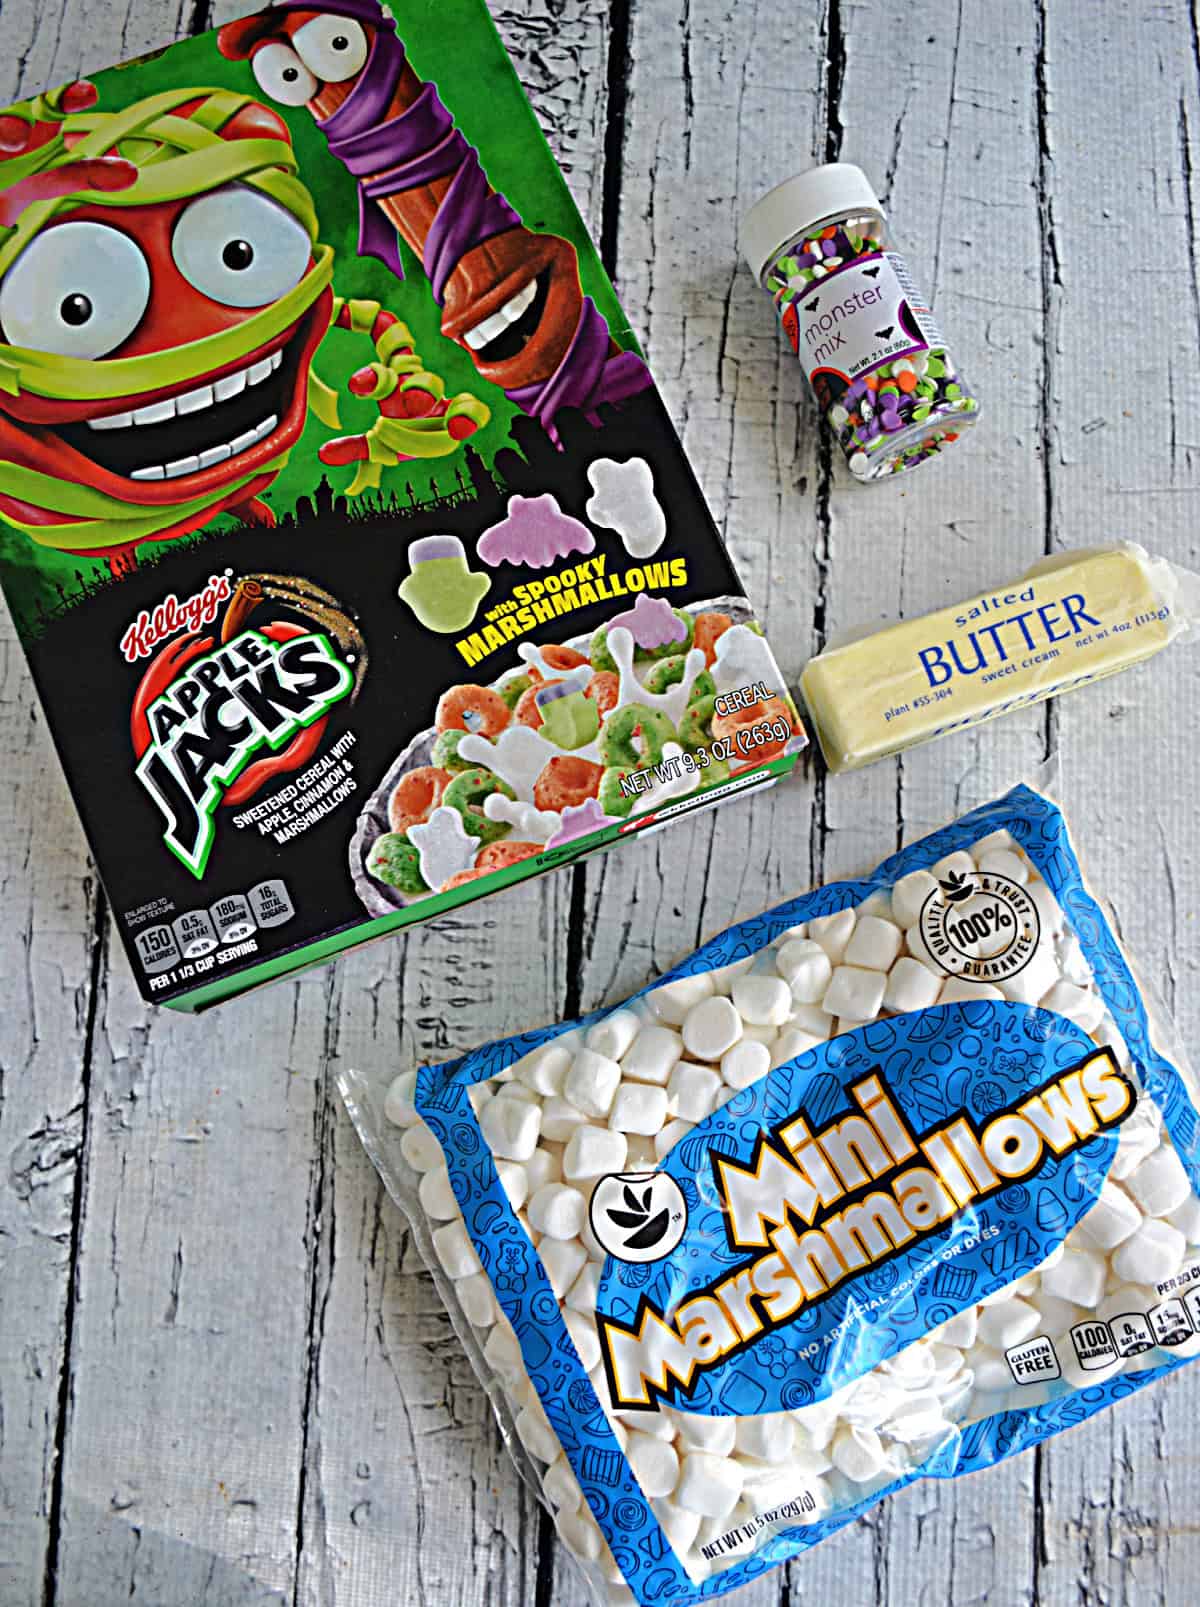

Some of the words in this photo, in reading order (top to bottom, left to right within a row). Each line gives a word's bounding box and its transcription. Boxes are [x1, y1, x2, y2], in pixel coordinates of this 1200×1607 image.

[804, 285, 883, 345] monster
[812, 330, 847, 365] mix
[484, 598, 519, 622] with
[512, 554, 607, 606] SPOOKY
[954, 587, 1035, 629] salted
[120, 575, 231, 662] Kellogg's
[455, 557, 688, 668] MARSHMALLOWS
[1074, 635, 1093, 649] net
[1095, 628, 1110, 641] wt
[1112, 621, 1133, 635] 4oz
[917, 592, 1101, 688] BUTTER
[980, 663, 1018, 685] sweet
[1021, 647, 1060, 669] cream
[151, 636, 274, 745] APPLE
[714, 681, 777, 718] CEREAL
[882, 702, 911, 722] plant
[143, 639, 343, 859] JACKS
[619, 768, 653, 799] NET
[653, 755, 683, 786] WT
[681, 746, 711, 775] 9.3
[711, 735, 737, 763] OZ
[736, 715, 792, 755] (263g)
[232, 784, 298, 829] SWEETENED
[295, 755, 337, 791] CEREAL
[329, 730, 357, 760] WITH
[257, 806, 299, 836] APPLE,
[293, 765, 346, 812] CINNAMON
[342, 759, 354, 772] &
[273, 777, 357, 844] MARSHMALLOWS
[260, 897, 282, 911] TOTAL
[260, 903, 289, 920] SUGARS
[927, 899, 952, 957] QUALITY
[982, 878, 991, 890] &
[994, 880, 1031, 915] TRUST
[948, 902, 1012, 948] 100%
[139, 927, 172, 955] 150
[195, 925, 209, 938] FAT
[143, 946, 177, 965] CALORIES
[148, 973, 171, 991] PER
[170, 972, 178, 984] 1
[178, 964, 196, 981] 1/3
[194, 955, 216, 973] CUP
[215, 939, 259, 965] SERVING
[963, 935, 1033, 977] GUARANTEE
[711, 1069, 921, 1250] Mini
[600, 1050, 1133, 1407] Marshmallows
[798, 1340, 820, 1360] NO
[941, 1246, 962, 1262] OR
[963, 1225, 1001, 1249] DYES
[1157, 1279, 1177, 1296] PER
[1010, 1344, 1051, 1364] GLUTEN
[1074, 1325, 1109, 1350] 100
[1079, 1344, 1114, 1360] CALORIES
[1015, 1354, 1055, 1377] FREE
[701, 1539, 725, 1561] NET
[723, 1529, 744, 1550] WT
[781, 1489, 817, 1519] (297g)
